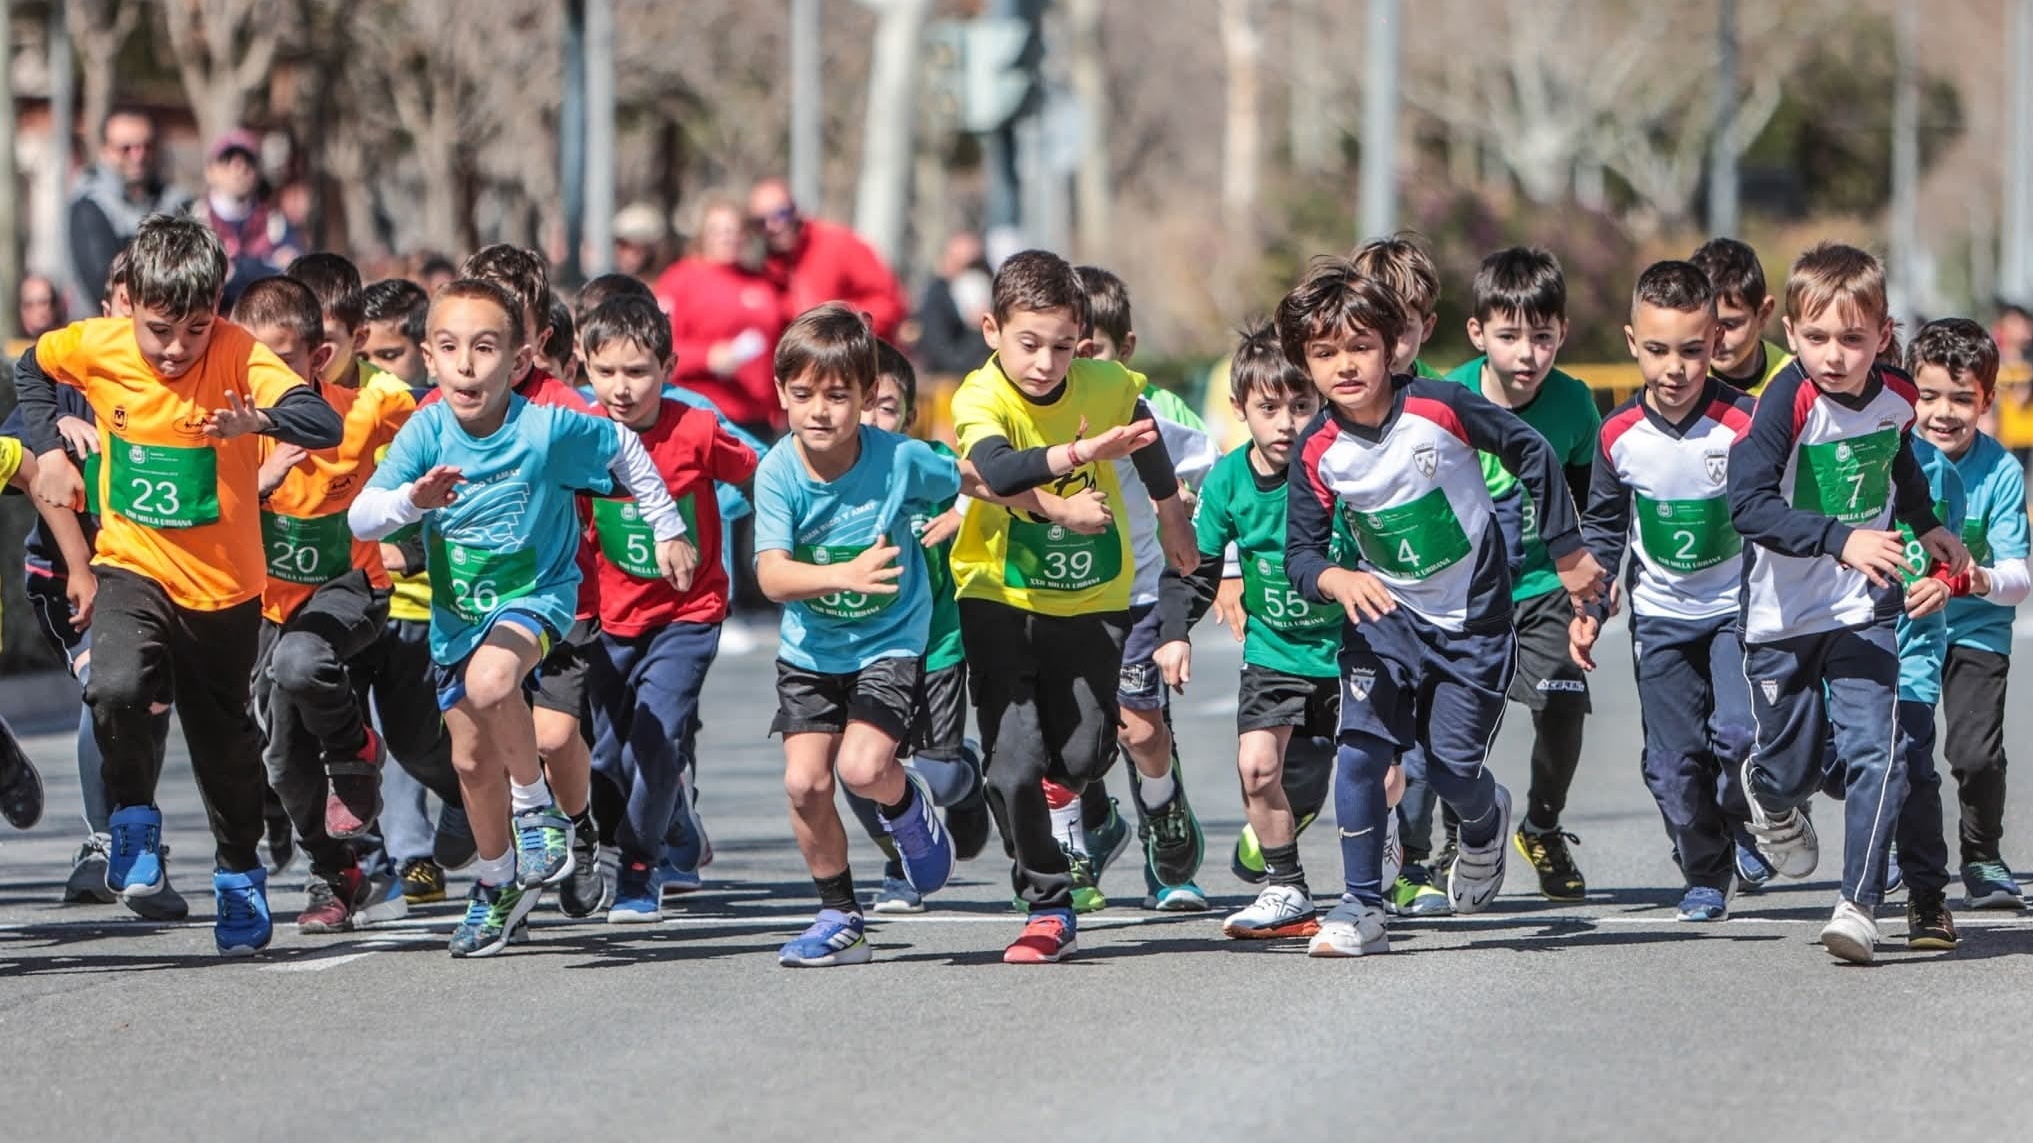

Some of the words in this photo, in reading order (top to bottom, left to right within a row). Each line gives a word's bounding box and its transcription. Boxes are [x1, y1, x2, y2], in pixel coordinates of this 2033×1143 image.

[131, 478, 180, 515] 23
[1847, 473, 1865, 509] 7
[137, 514, 160, 525] MILLA
[160, 518, 193, 527] URBANA
[851, 502, 875, 516] AMAT
[272, 541, 319, 573] 20
[627, 534, 655, 564] 5
[1397, 538, 1421, 567] 4
[1673, 530, 1698, 559] 2
[1043, 550, 1093, 579] 39
[1421, 558, 1451, 576] URBANA
[1670, 560, 1692, 569] MILLA
[1692, 555, 1721, 568] URBANA
[450, 578, 499, 613] 26
[1048, 581, 1070, 589] MILLA
[1072, 577, 1101, 589] URBANA
[825, 608, 848, 617] MILLA
[849, 605, 880, 618] URBANA
[1264, 587, 1309, 617] 55
